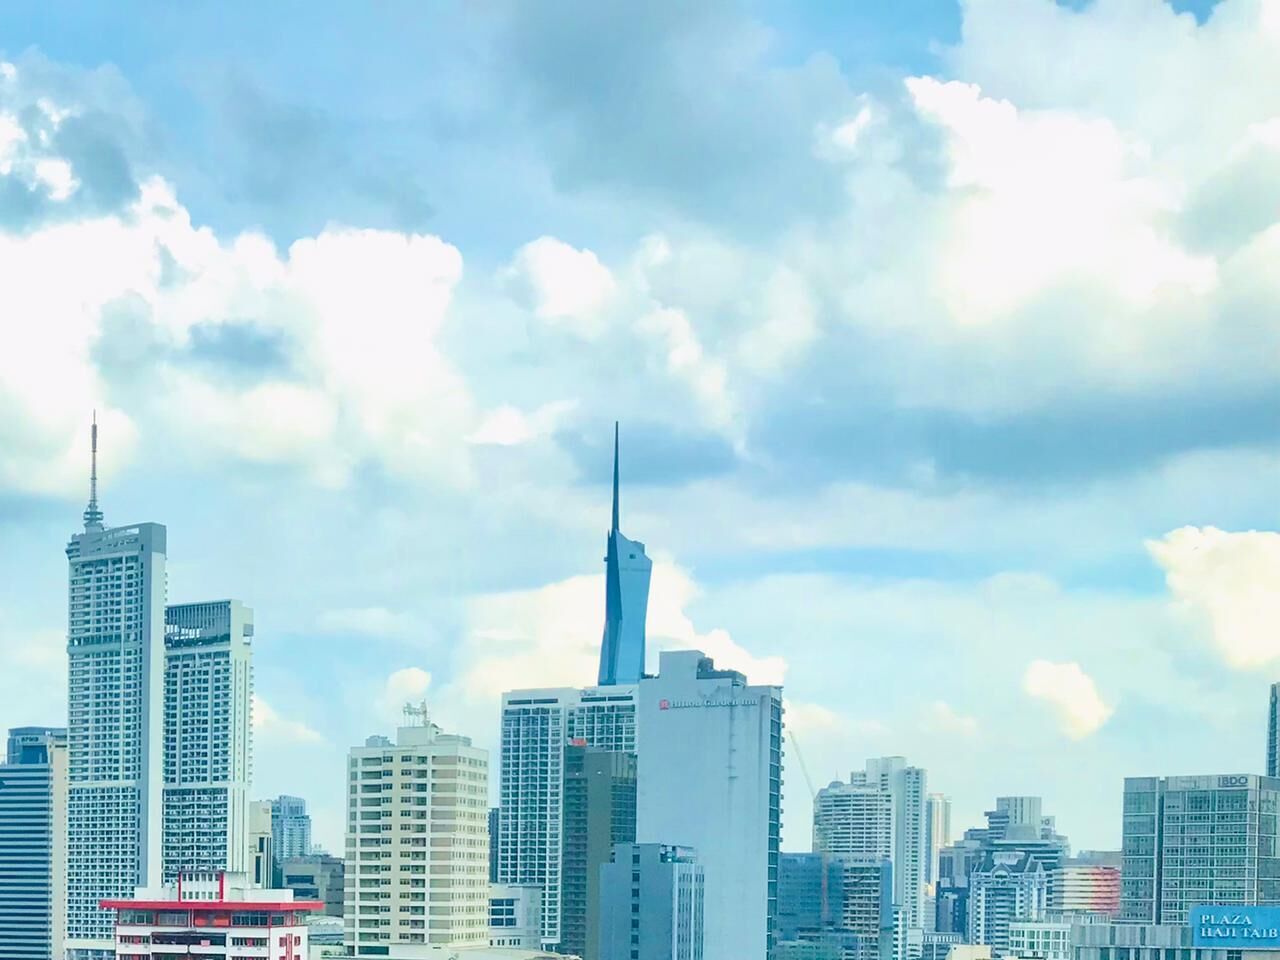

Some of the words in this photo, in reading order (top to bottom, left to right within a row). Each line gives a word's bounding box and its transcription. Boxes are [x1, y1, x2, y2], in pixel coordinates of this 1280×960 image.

[703, 698, 738, 708] Garden
[1201, 914, 1252, 925] PLAZA
[1201, 927, 1237, 937] HAJI
[1241, 928, 1278, 938] TAIB
